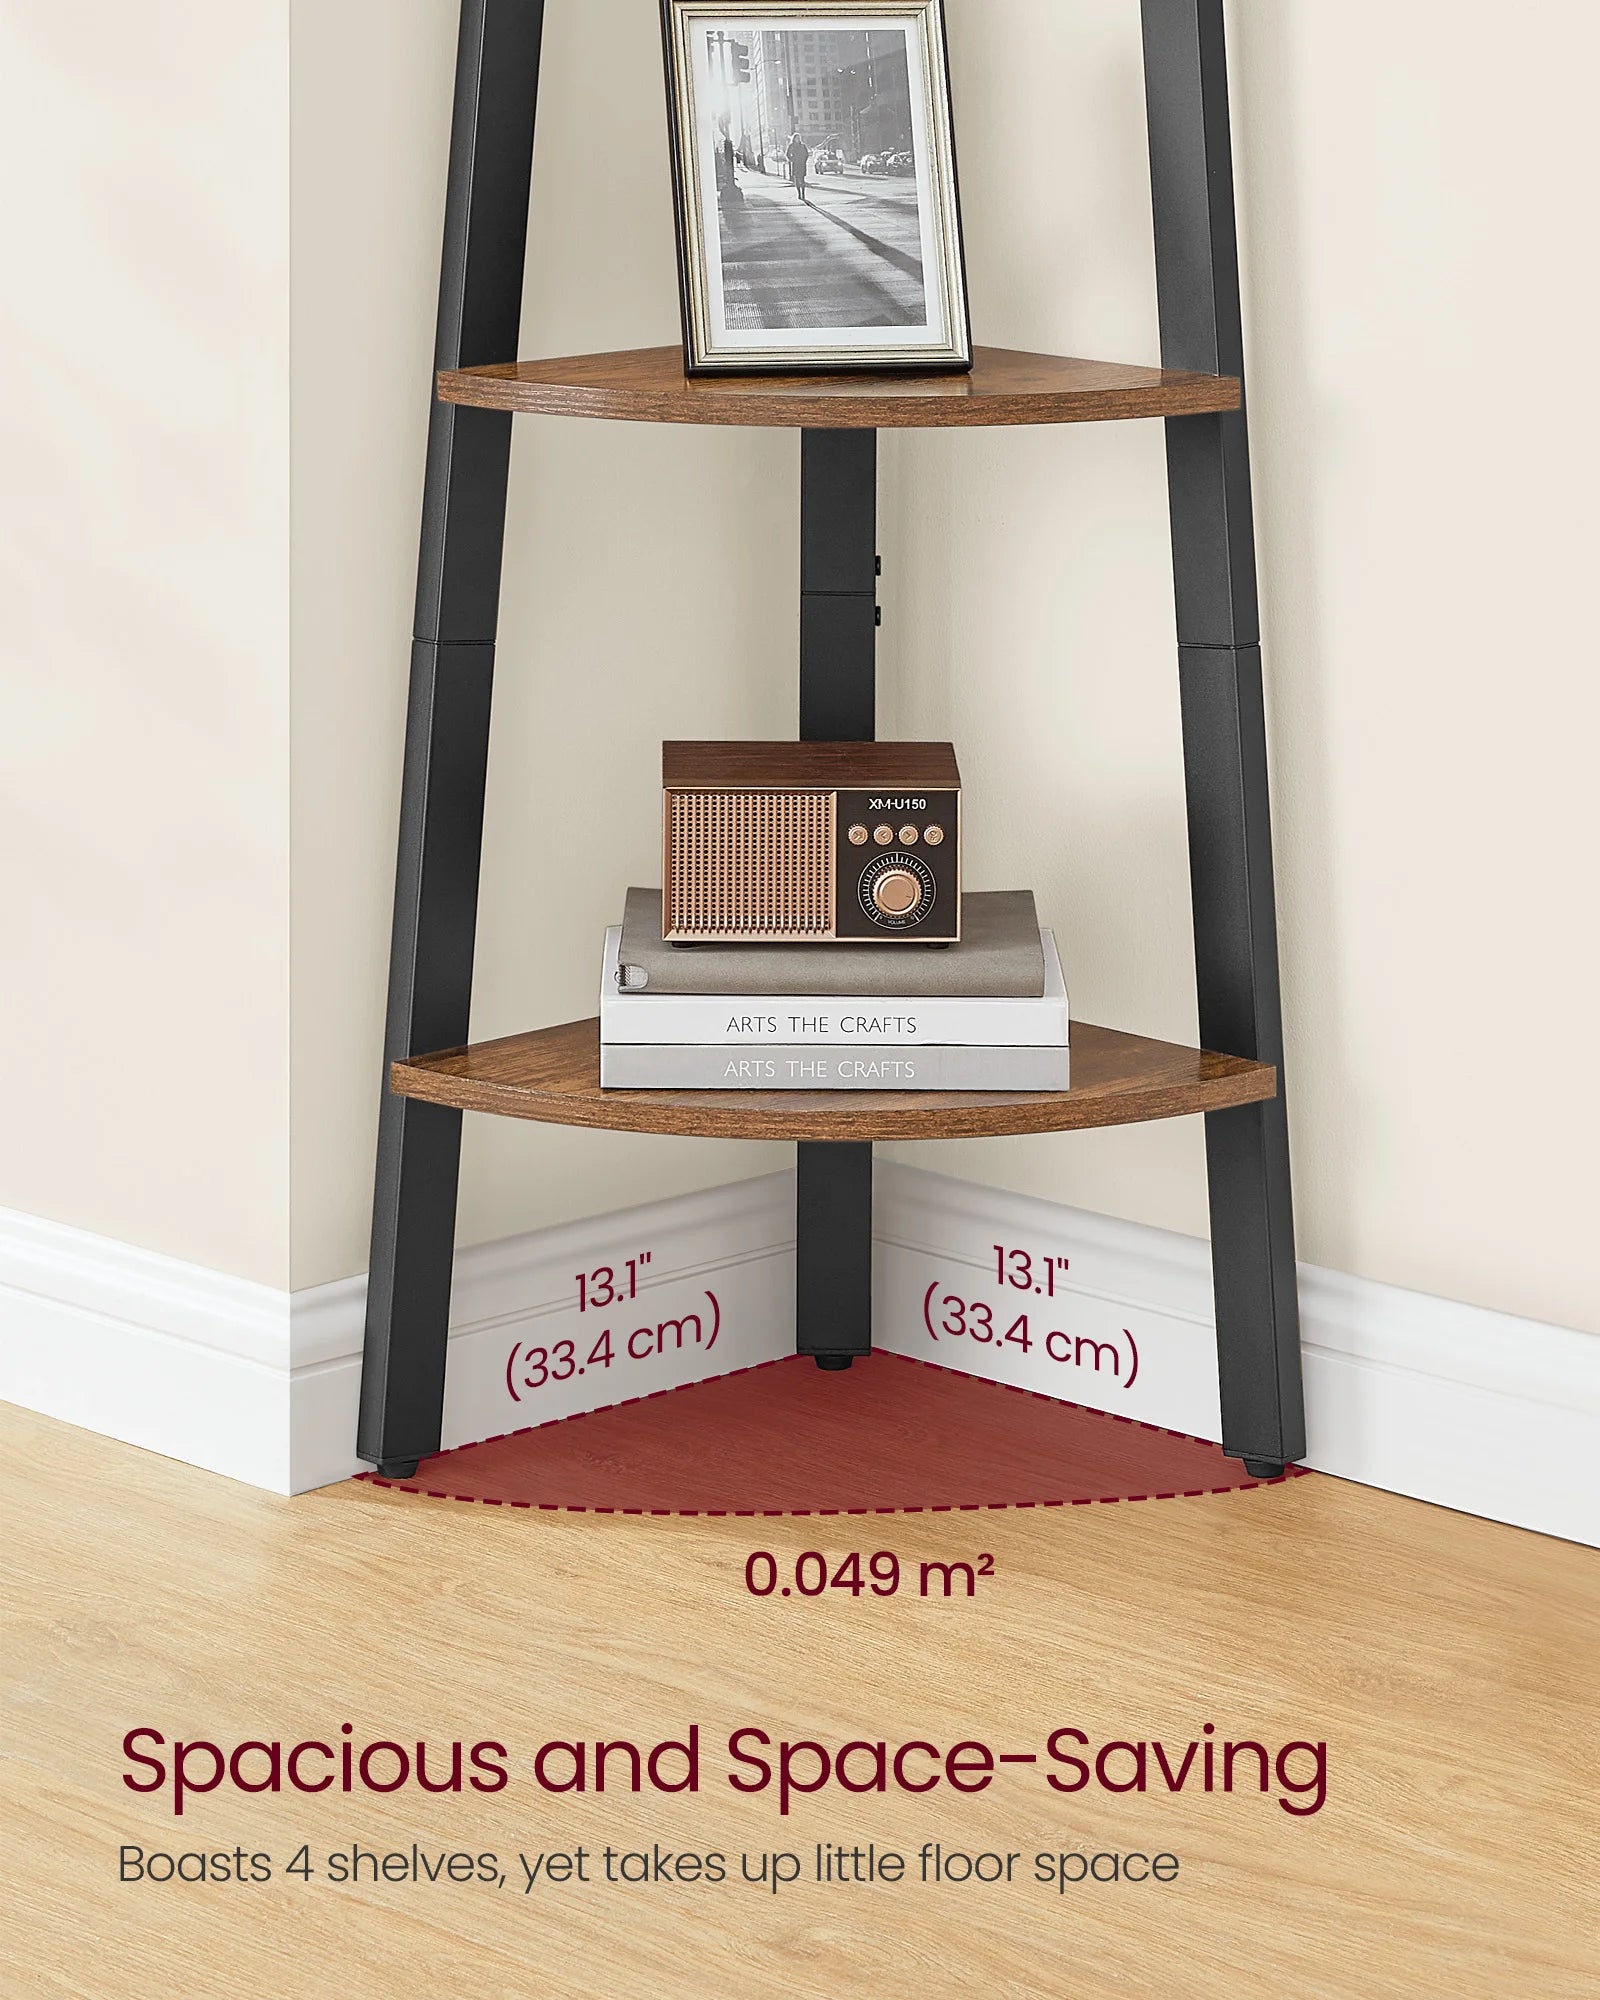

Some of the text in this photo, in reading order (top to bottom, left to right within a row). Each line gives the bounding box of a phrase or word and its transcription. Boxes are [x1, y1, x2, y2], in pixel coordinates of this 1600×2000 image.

[868, 798, 927, 810] XM-U150
[726, 1016, 917, 1034] ARTS THE CRAFTS
[724, 1060, 915, 1078] ARTS THE CRAFTS
